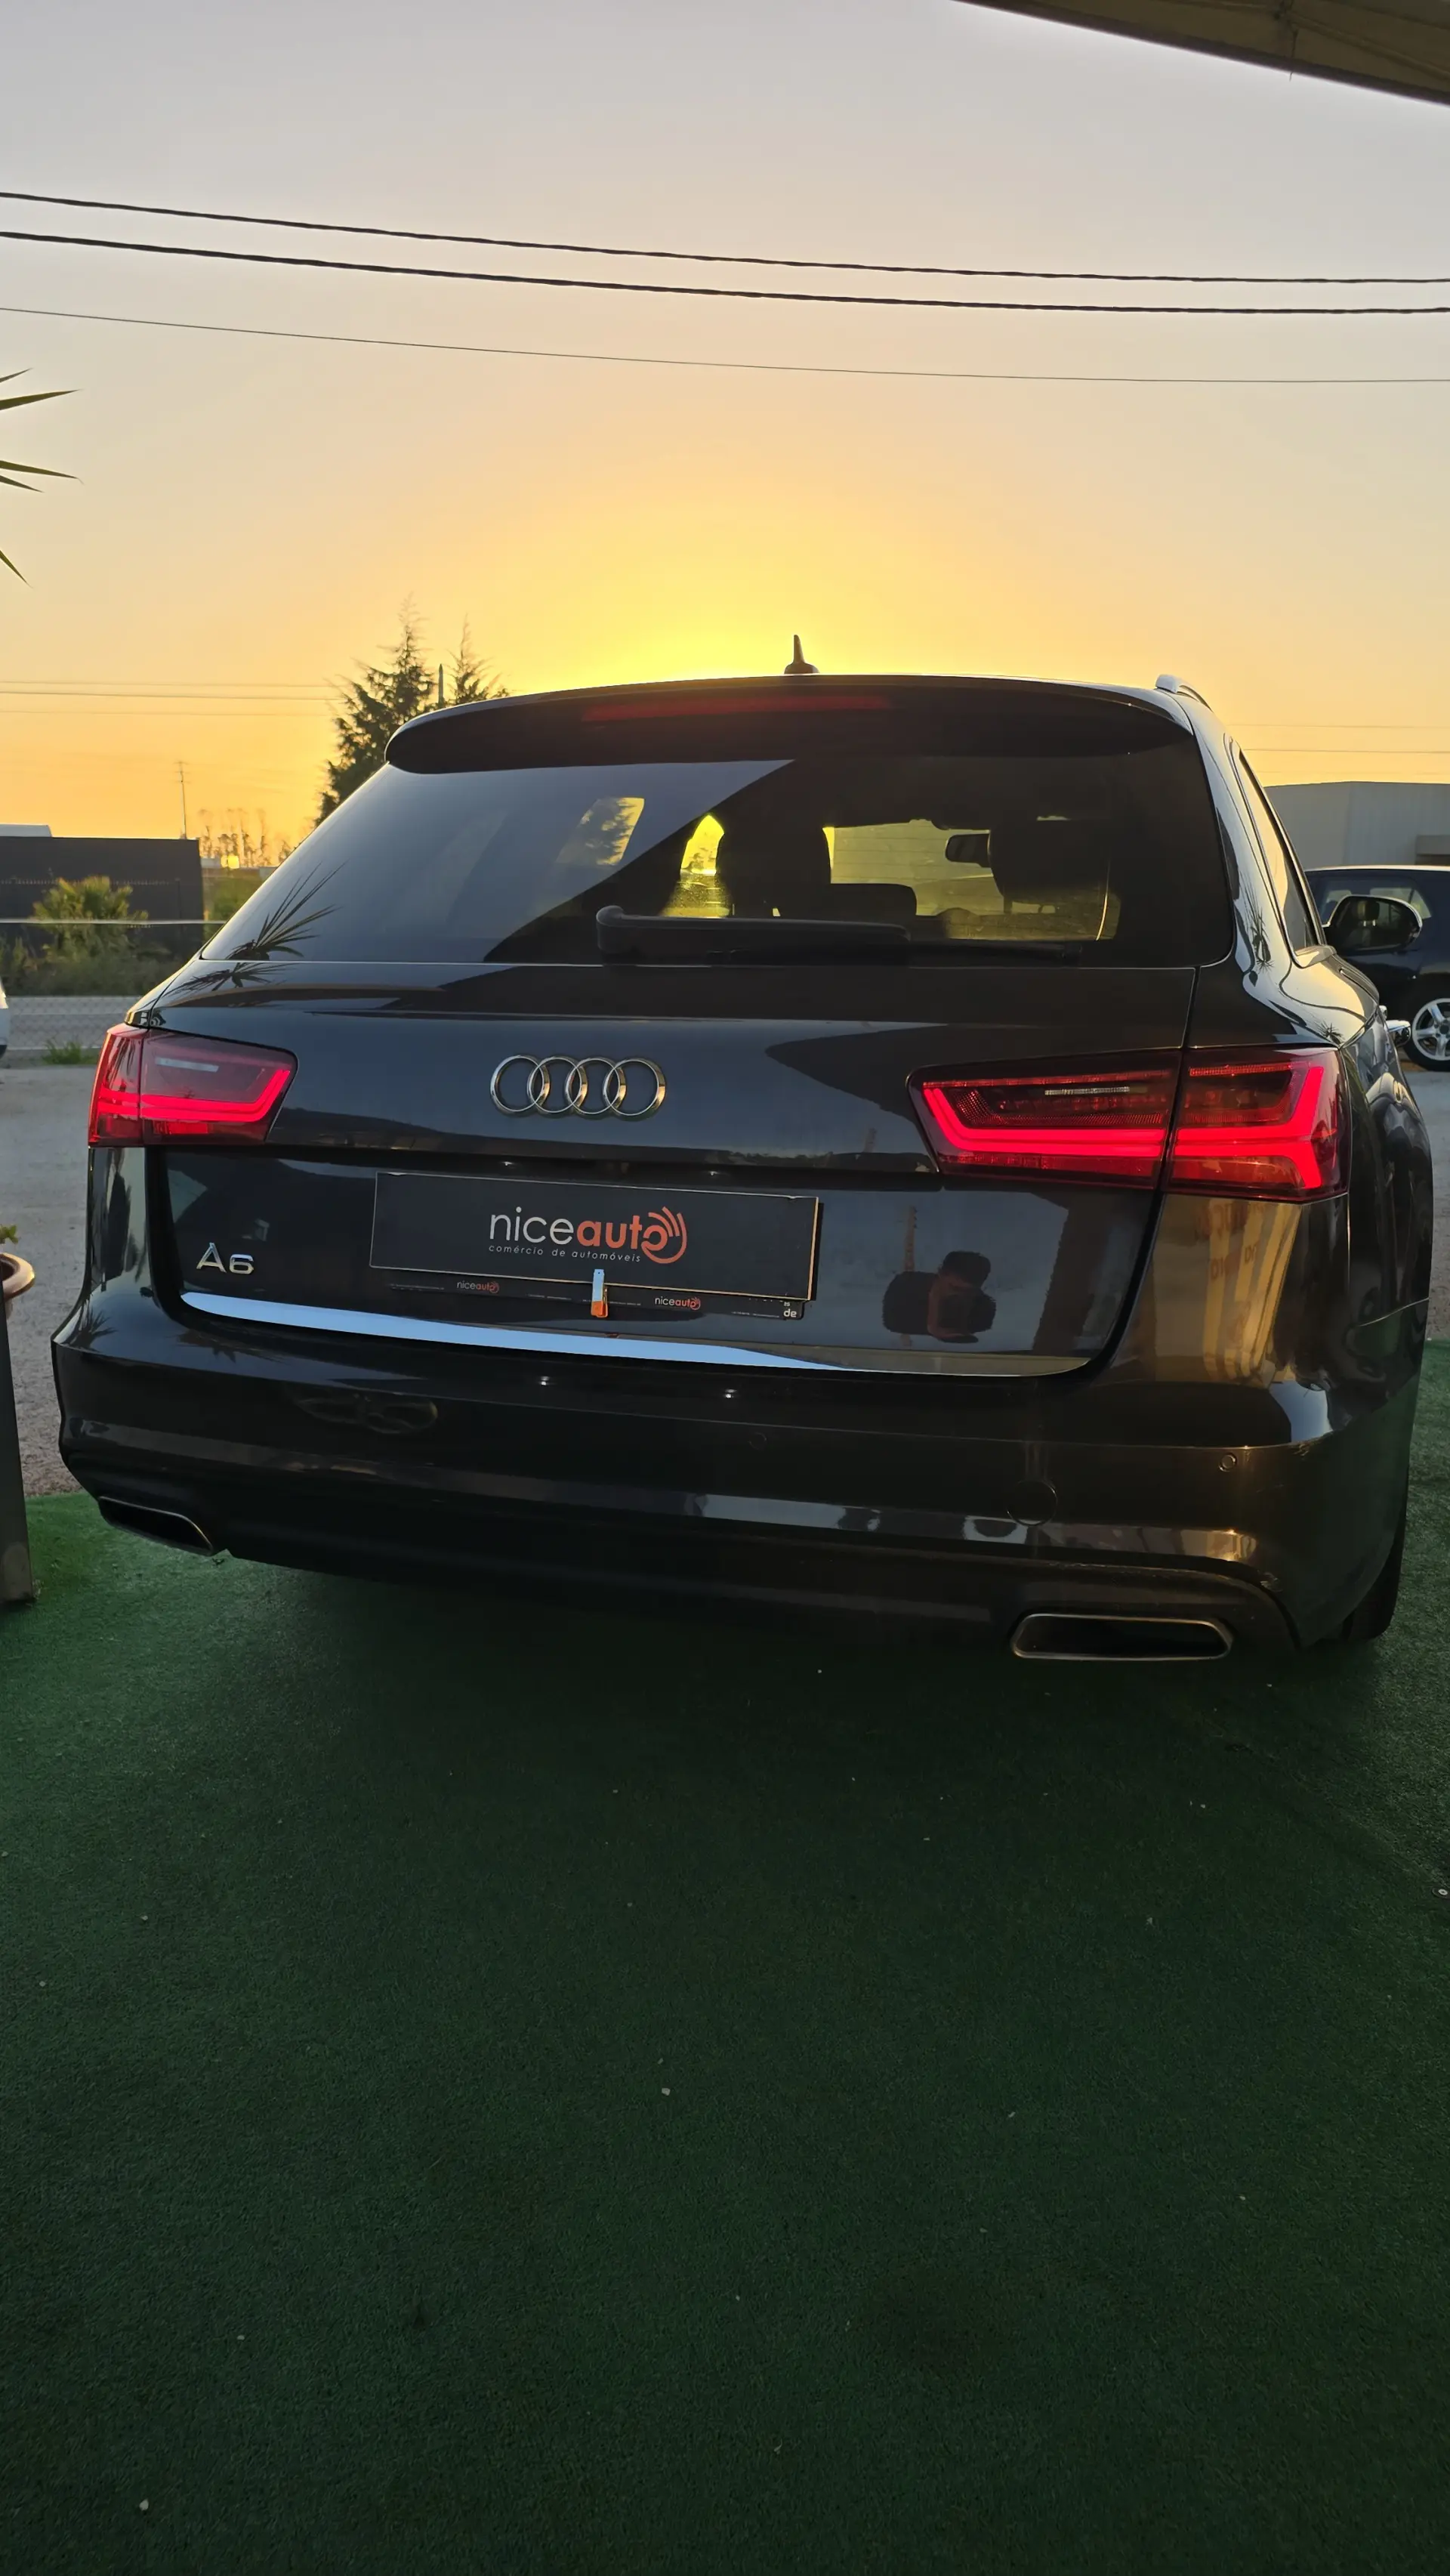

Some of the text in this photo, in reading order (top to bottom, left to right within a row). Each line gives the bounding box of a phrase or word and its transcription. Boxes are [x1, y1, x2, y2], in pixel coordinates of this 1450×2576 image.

[489, 1206, 686, 1264] niceauto
[196, 1242, 255, 1275] A6
[489, 1244, 641, 1262] comércio de automóveis
[456, 1280, 500, 1293] niceauto
[654, 1296, 701, 1310] niceauto
[783, 1308, 798, 1318] de
